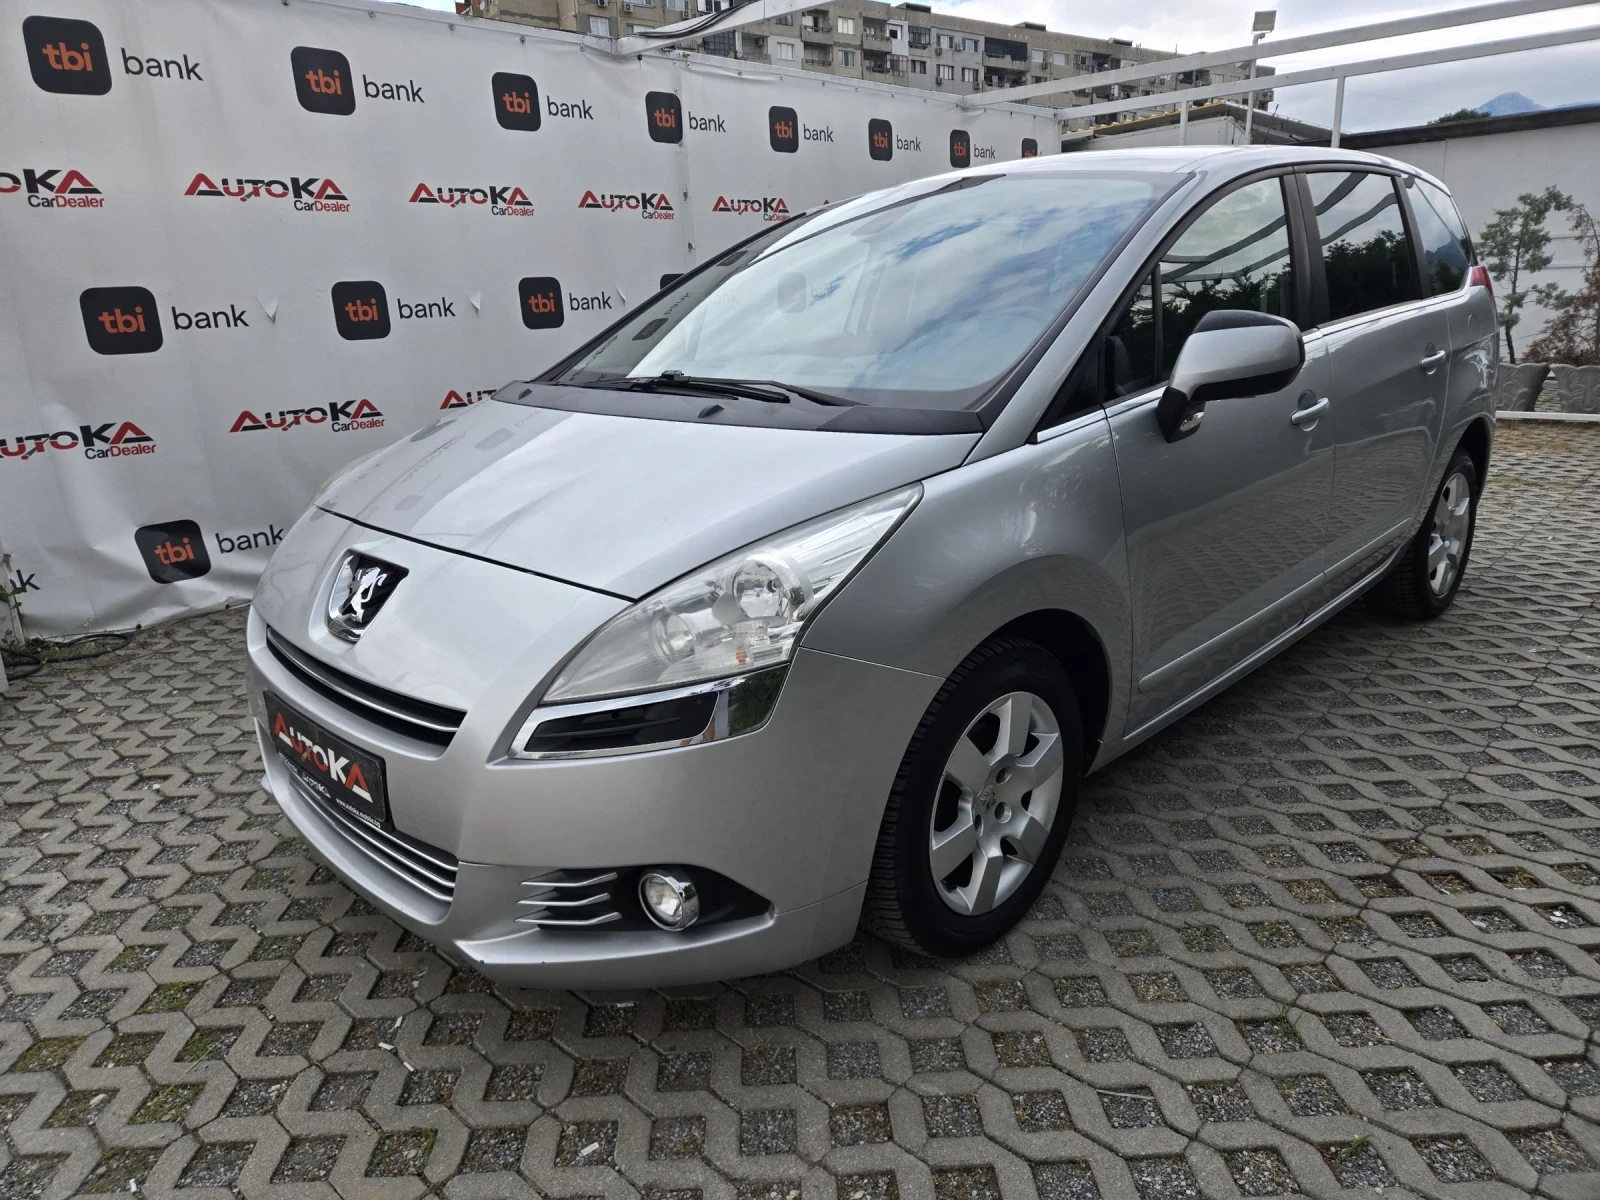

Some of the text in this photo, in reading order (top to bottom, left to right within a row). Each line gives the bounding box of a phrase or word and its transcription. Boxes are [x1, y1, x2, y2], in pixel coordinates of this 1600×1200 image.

[42, 43, 204, 81] tbi bank
[305, 69, 425, 103] tbi bank
[503, 92, 594, 120] tbi bank
[654, 108, 726, 133] tbi bank
[774, 121, 834, 143] tbi bank
[873, 132, 922, 152] tbi bank
[953, 142, 996, 160] tbi bank
[0, 169, 103, 194] OKA
[27, 195, 104, 208] CarDealer
[294, 200, 350, 213] CarDealer
[491, 205, 534, 217] CarDealer
[344, 297, 456, 322] tbi bank
[529, 291, 612, 314] tbi bank
[98, 304, 249, 334] tbi bank
[331, 418, 385, 433] CarDealer
[0, 421, 154, 460] UTOKA
[85, 443, 156, 460] CarDealer
[155, 524, 284, 566] tbi bank
